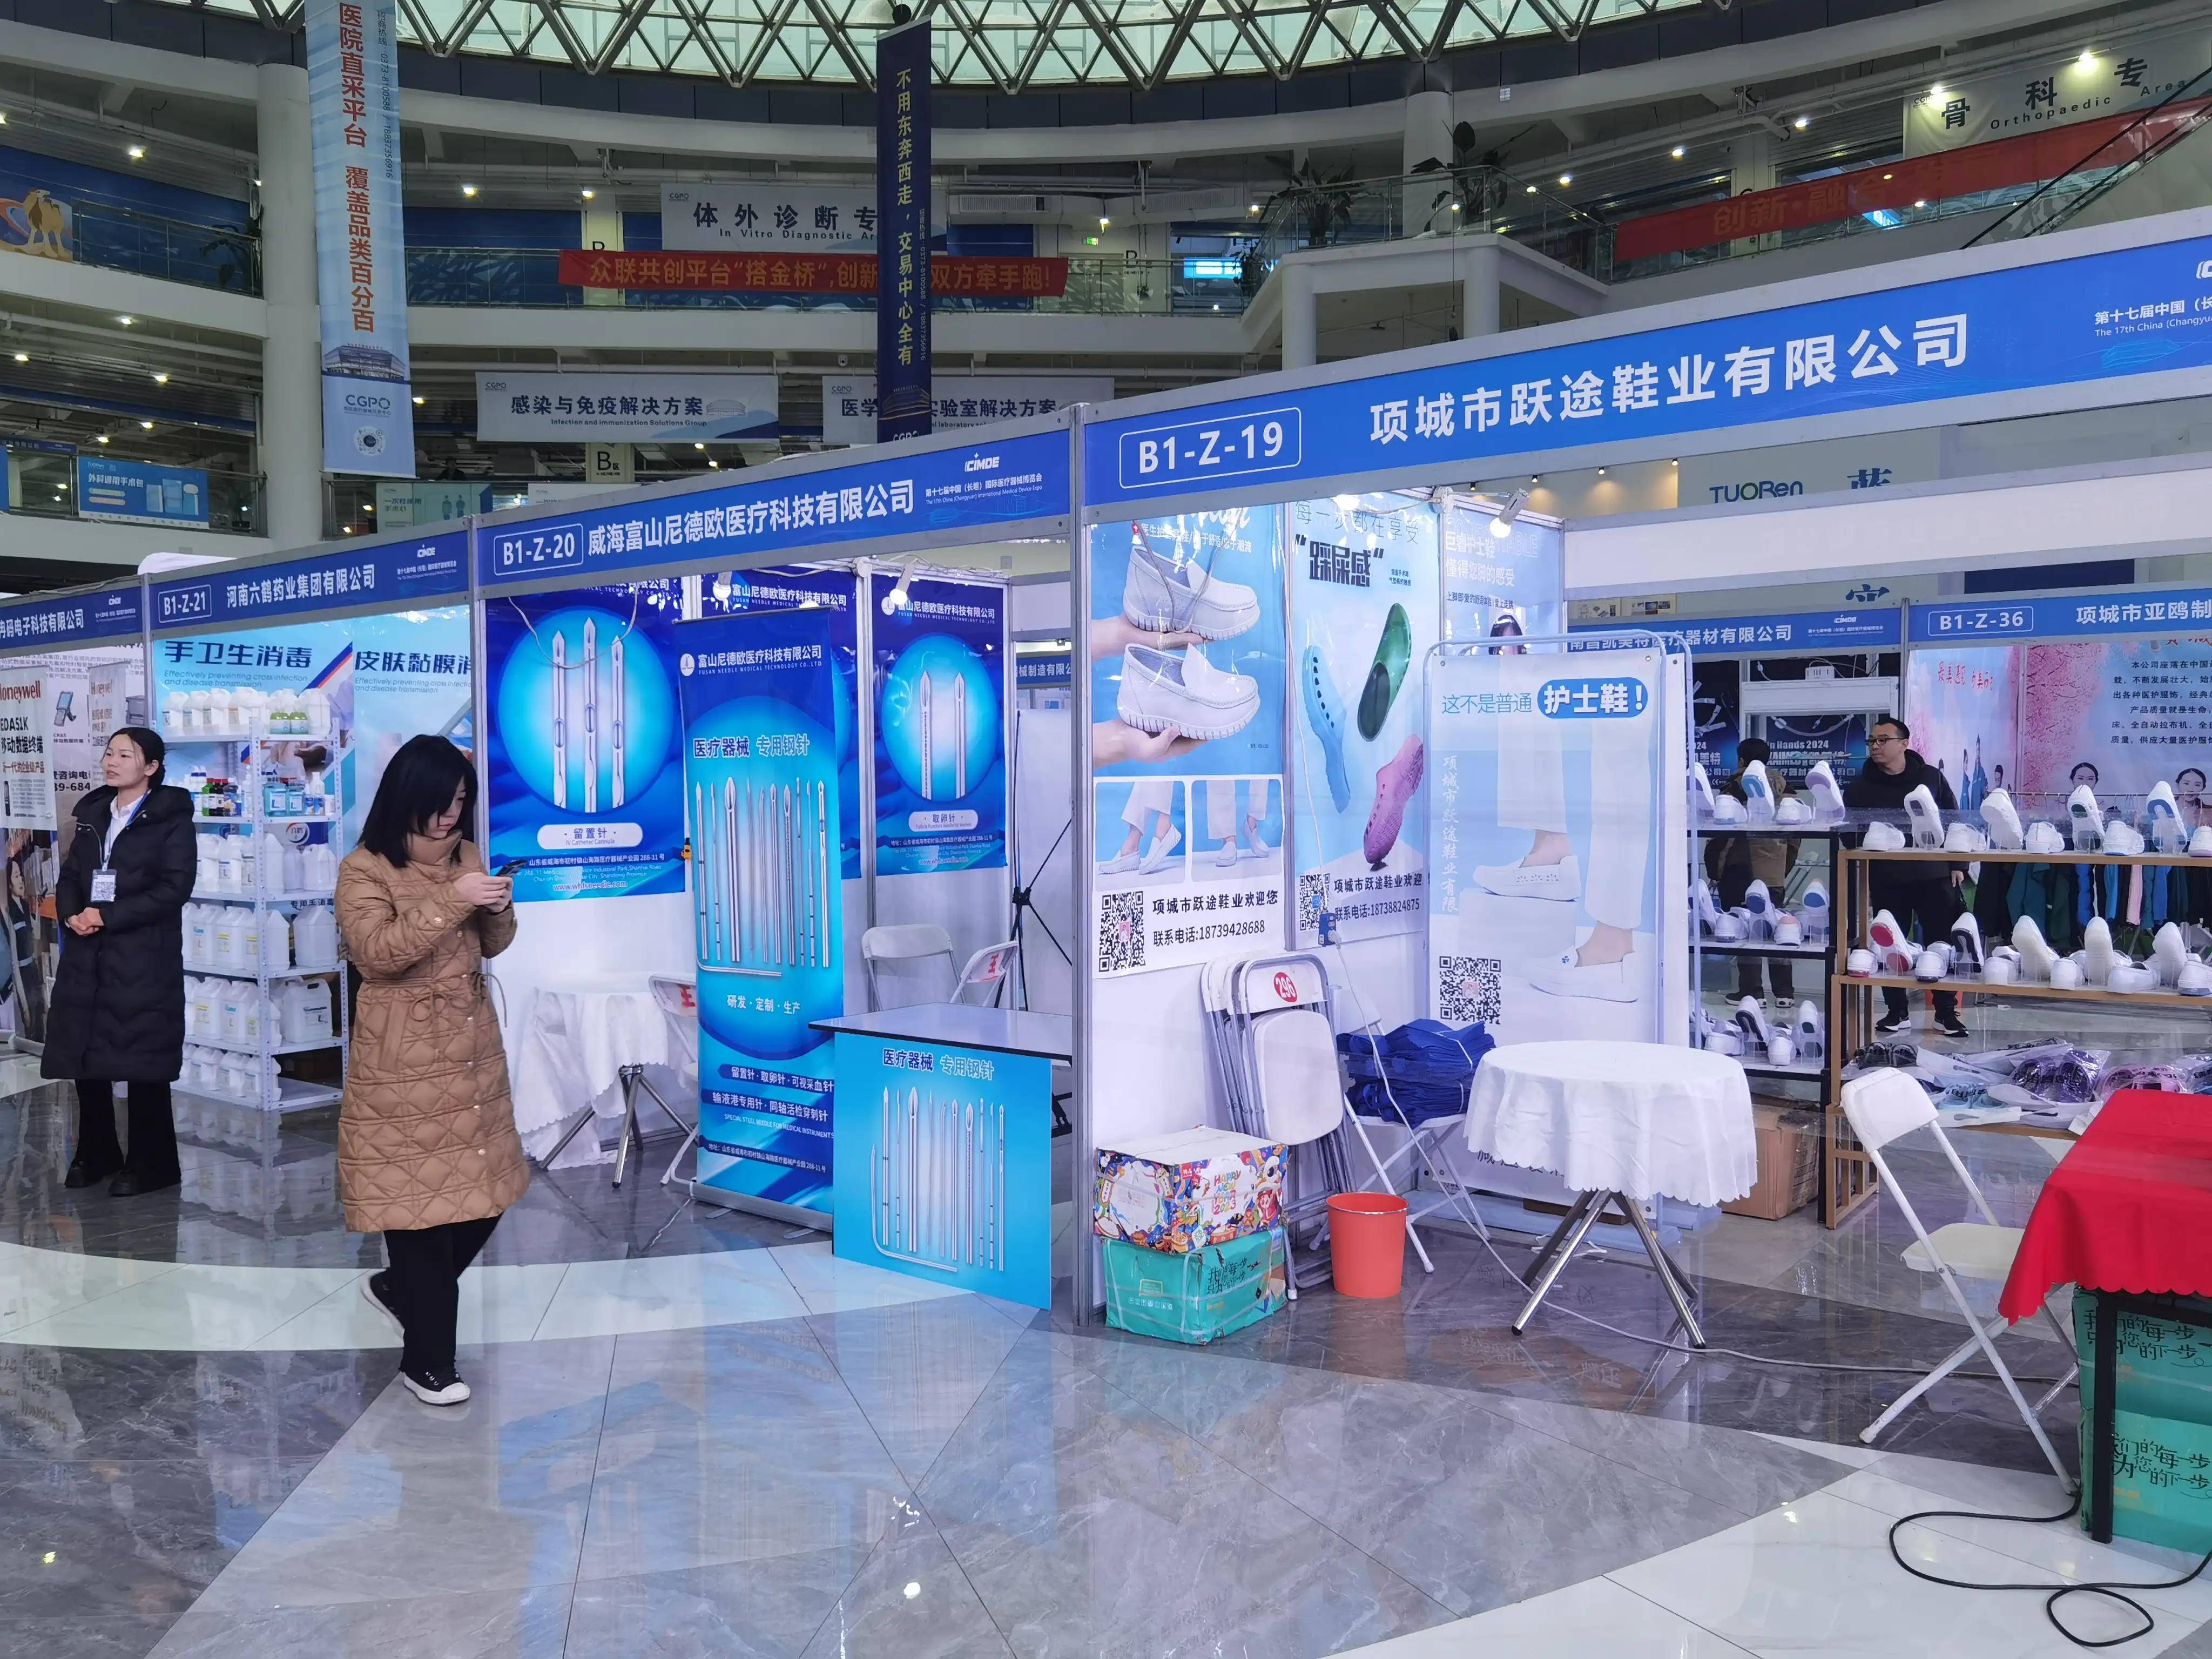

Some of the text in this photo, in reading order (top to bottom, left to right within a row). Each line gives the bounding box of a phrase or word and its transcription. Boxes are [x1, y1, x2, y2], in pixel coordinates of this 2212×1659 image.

[339, 2, 368, 148] 医院直采平台
[1990, 79, 2186, 130] Orthopaedic Area
[720, 228, 731, 237] In
[740, 229, 773, 238] Vitro
[783, 230, 852, 241] Diagnostic
[345, 165, 375, 334] 覆盖品类百分百
[2094, 315, 2212, 337] The 17th China (Changyua
[1370, 313, 1968, 445] 项城市跃途鞋业有限公司
[346, 394, 391, 409] CGPO
[511, 395, 704, 416] 感染与免疫解决方案
[685, 420, 707, 428] Group
[1138, 421, 1284, 474] B1-Z-19
[588, 479, 914, 556] 威海富山尼德欧医疗科技有限公司
[502, 532, 576, 566] B1-Z-20
[226, 564, 376, 609] 河南六鹤药业集团有限公司
[164, 590, 206, 616] B1-Z-21
[1940, 612, 2024, 631] B1-Z-36
[165, 640, 312, 669] 手卫生消毒
[698, 644, 822, 669] 富山尼德欧医疗科技有限公司
[164, 670, 206, 679] Effectively
[207, 672, 252, 681] preventing
[274, 673, 308, 682] infection
[182, 678, 214, 686] disease
[355, 677, 391, 685] Effectively
[393, 679, 429, 687] preventing
[370, 685, 398, 693] disease
[2113, 691, 2212, 699] 出各种医护服饰，经典
[1441, 692, 1533, 714] 这不是普通
[693, 733, 810, 759] 医疗器械 专用钢针
[1806, 740, 1829, 749] 2024
[54, 770, 91, 780] 咨询电
[1152, 889, 1278, 915] 项城市跃途鞋业欢迎您
[882, 1047, 995, 1080] 医疗器械 专用钢针
[724, 1113, 834, 1139] SPECIAL STEEL NEEDLE FOR MEDICAL INSTRUMENTS
[1213, 1170, 1242, 1186] HAPPY
[1216, 1181, 1236, 1193] NEW
[1213, 1190, 1237, 1205] YEAR
[1213, 1199, 1237, 1216] 2023
